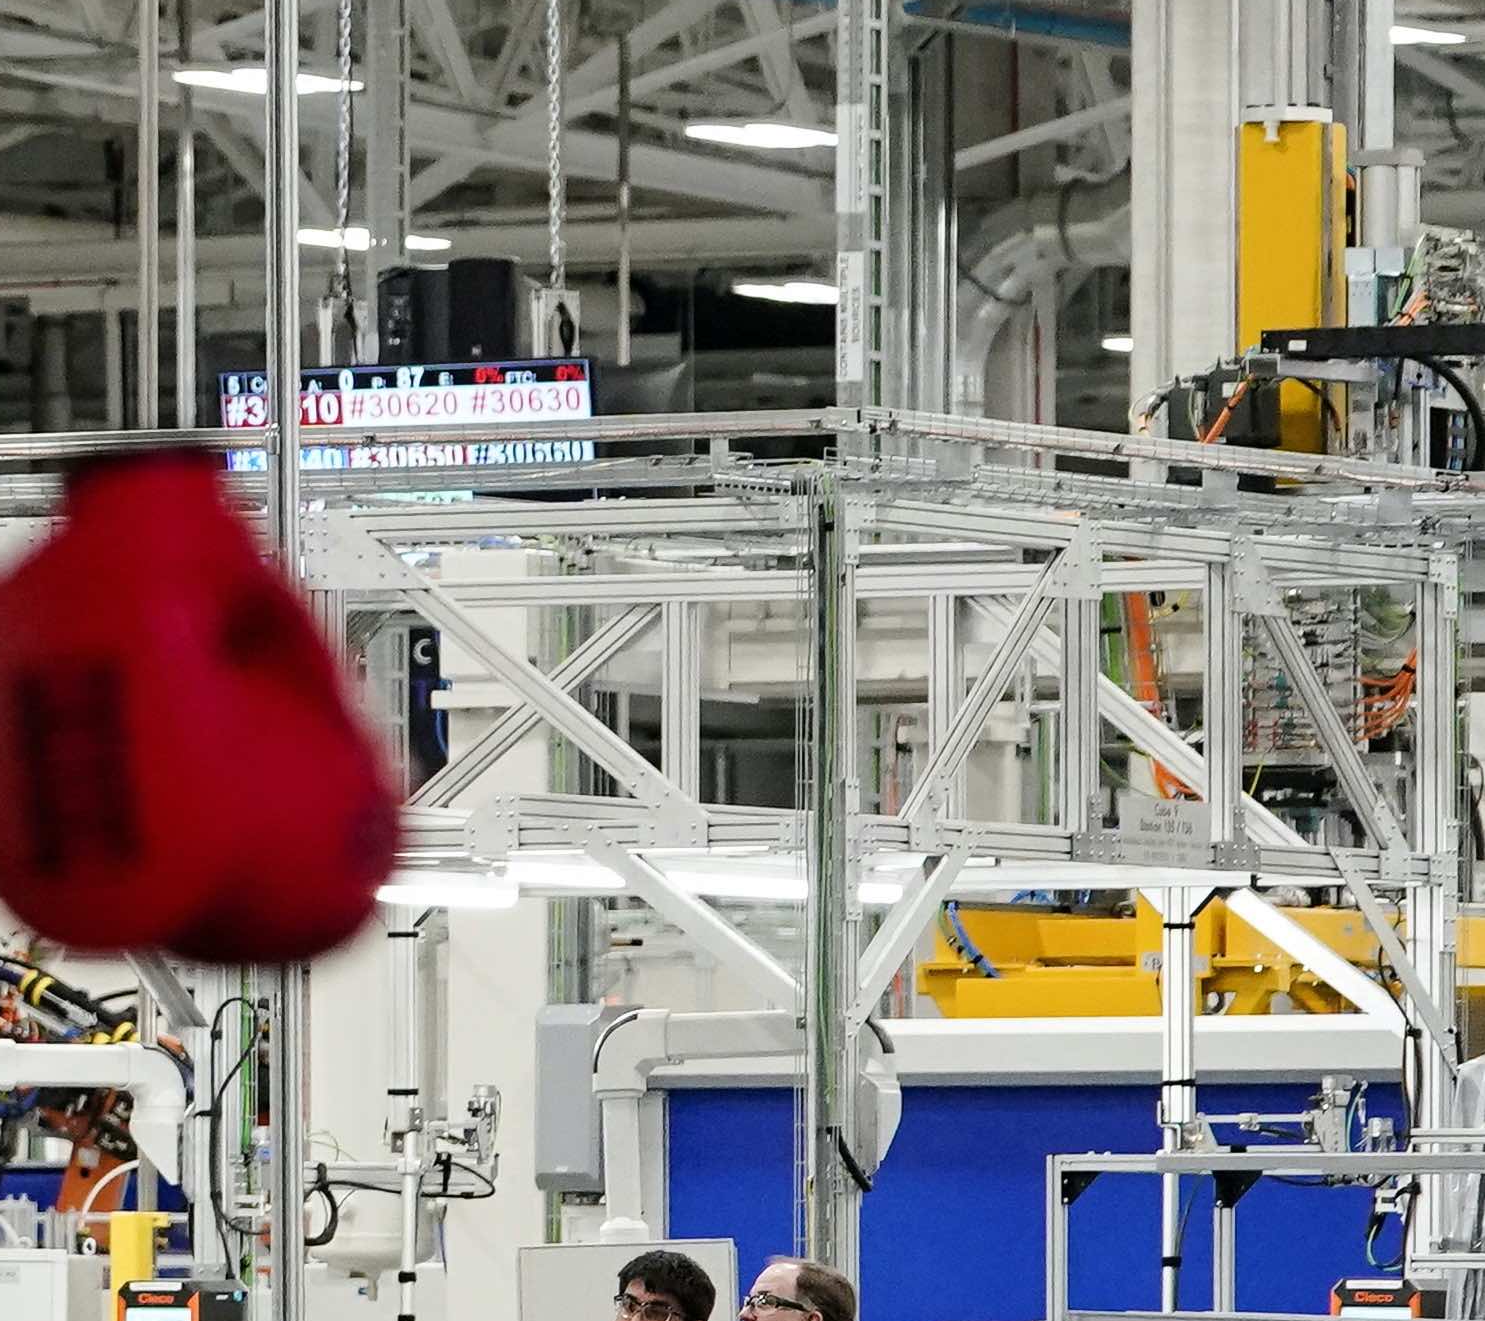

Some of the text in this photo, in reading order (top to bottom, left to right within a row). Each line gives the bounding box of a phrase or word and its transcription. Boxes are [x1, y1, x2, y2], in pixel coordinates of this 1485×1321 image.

[339, 368, 354, 391] 0
[396, 366, 424, 390] 87
[474, 365, 503, 384] 0%
[554, 364, 585, 381] 0%
[349, 390, 458, 419] #30620
[470, 386, 581, 415] #30630
